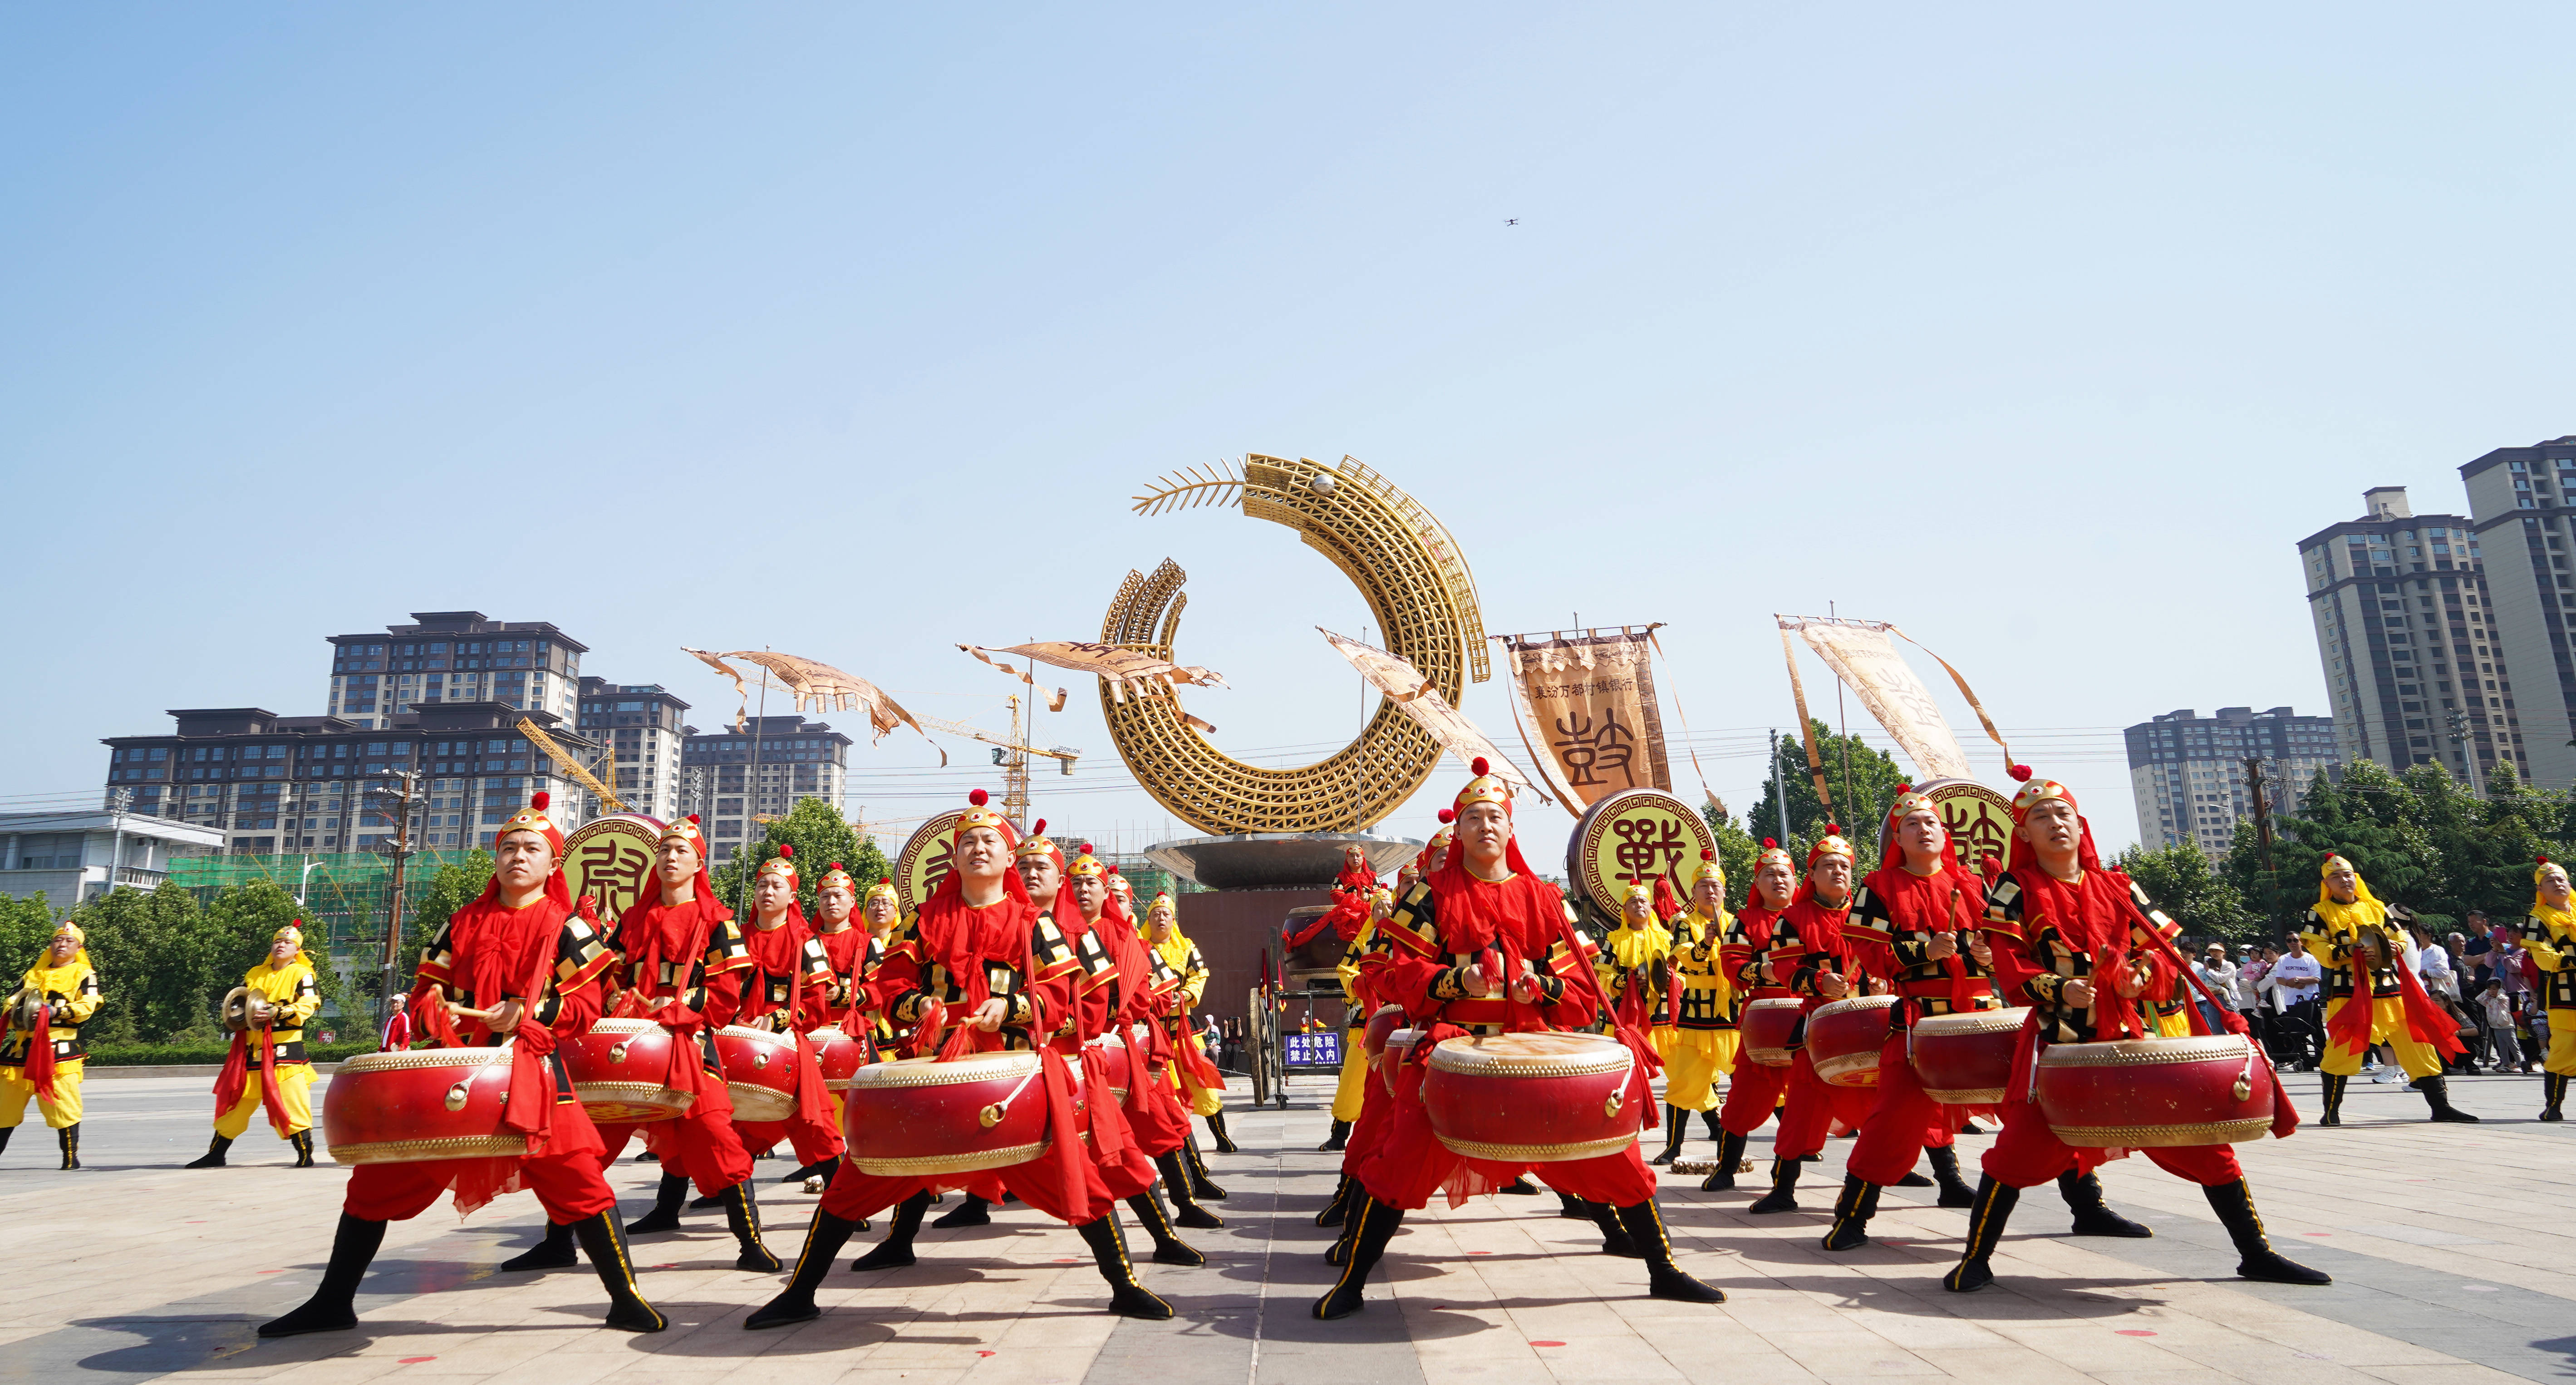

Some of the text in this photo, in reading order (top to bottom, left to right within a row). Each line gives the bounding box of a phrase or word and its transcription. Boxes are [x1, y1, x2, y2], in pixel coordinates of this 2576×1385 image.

[1535, 678, 1633, 700] 襄汾万都村镇银行
[1058, 745, 1080, 754] ZOOMLION
[322, 1032, 332, 1044] 为
[1290, 1036, 1335, 1048] 此处危险
[1290, 1049, 1335, 1062] 禁止入内
